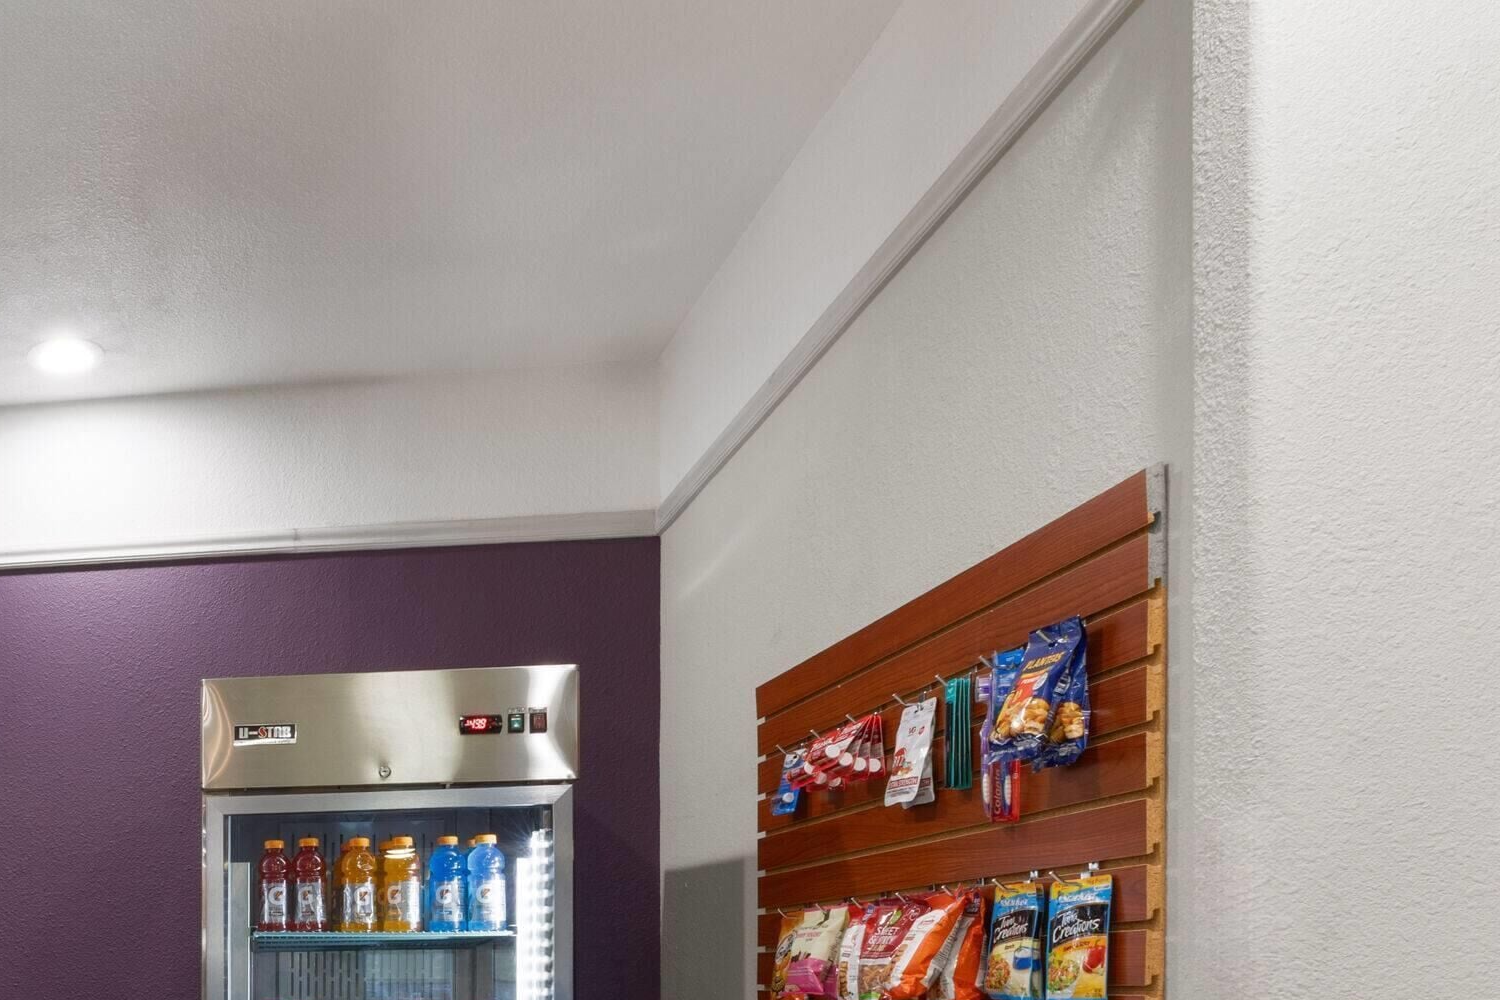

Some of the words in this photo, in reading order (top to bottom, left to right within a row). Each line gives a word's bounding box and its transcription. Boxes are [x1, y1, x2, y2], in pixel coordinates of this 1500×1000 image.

[268, 886, 286, 905] G
[354, 887, 370, 905] G
[436, 886, 452, 904] G
[475, 885, 491, 904] G
[994, 922, 1028, 944] Creations
[1052, 918, 1101, 943] Creations
